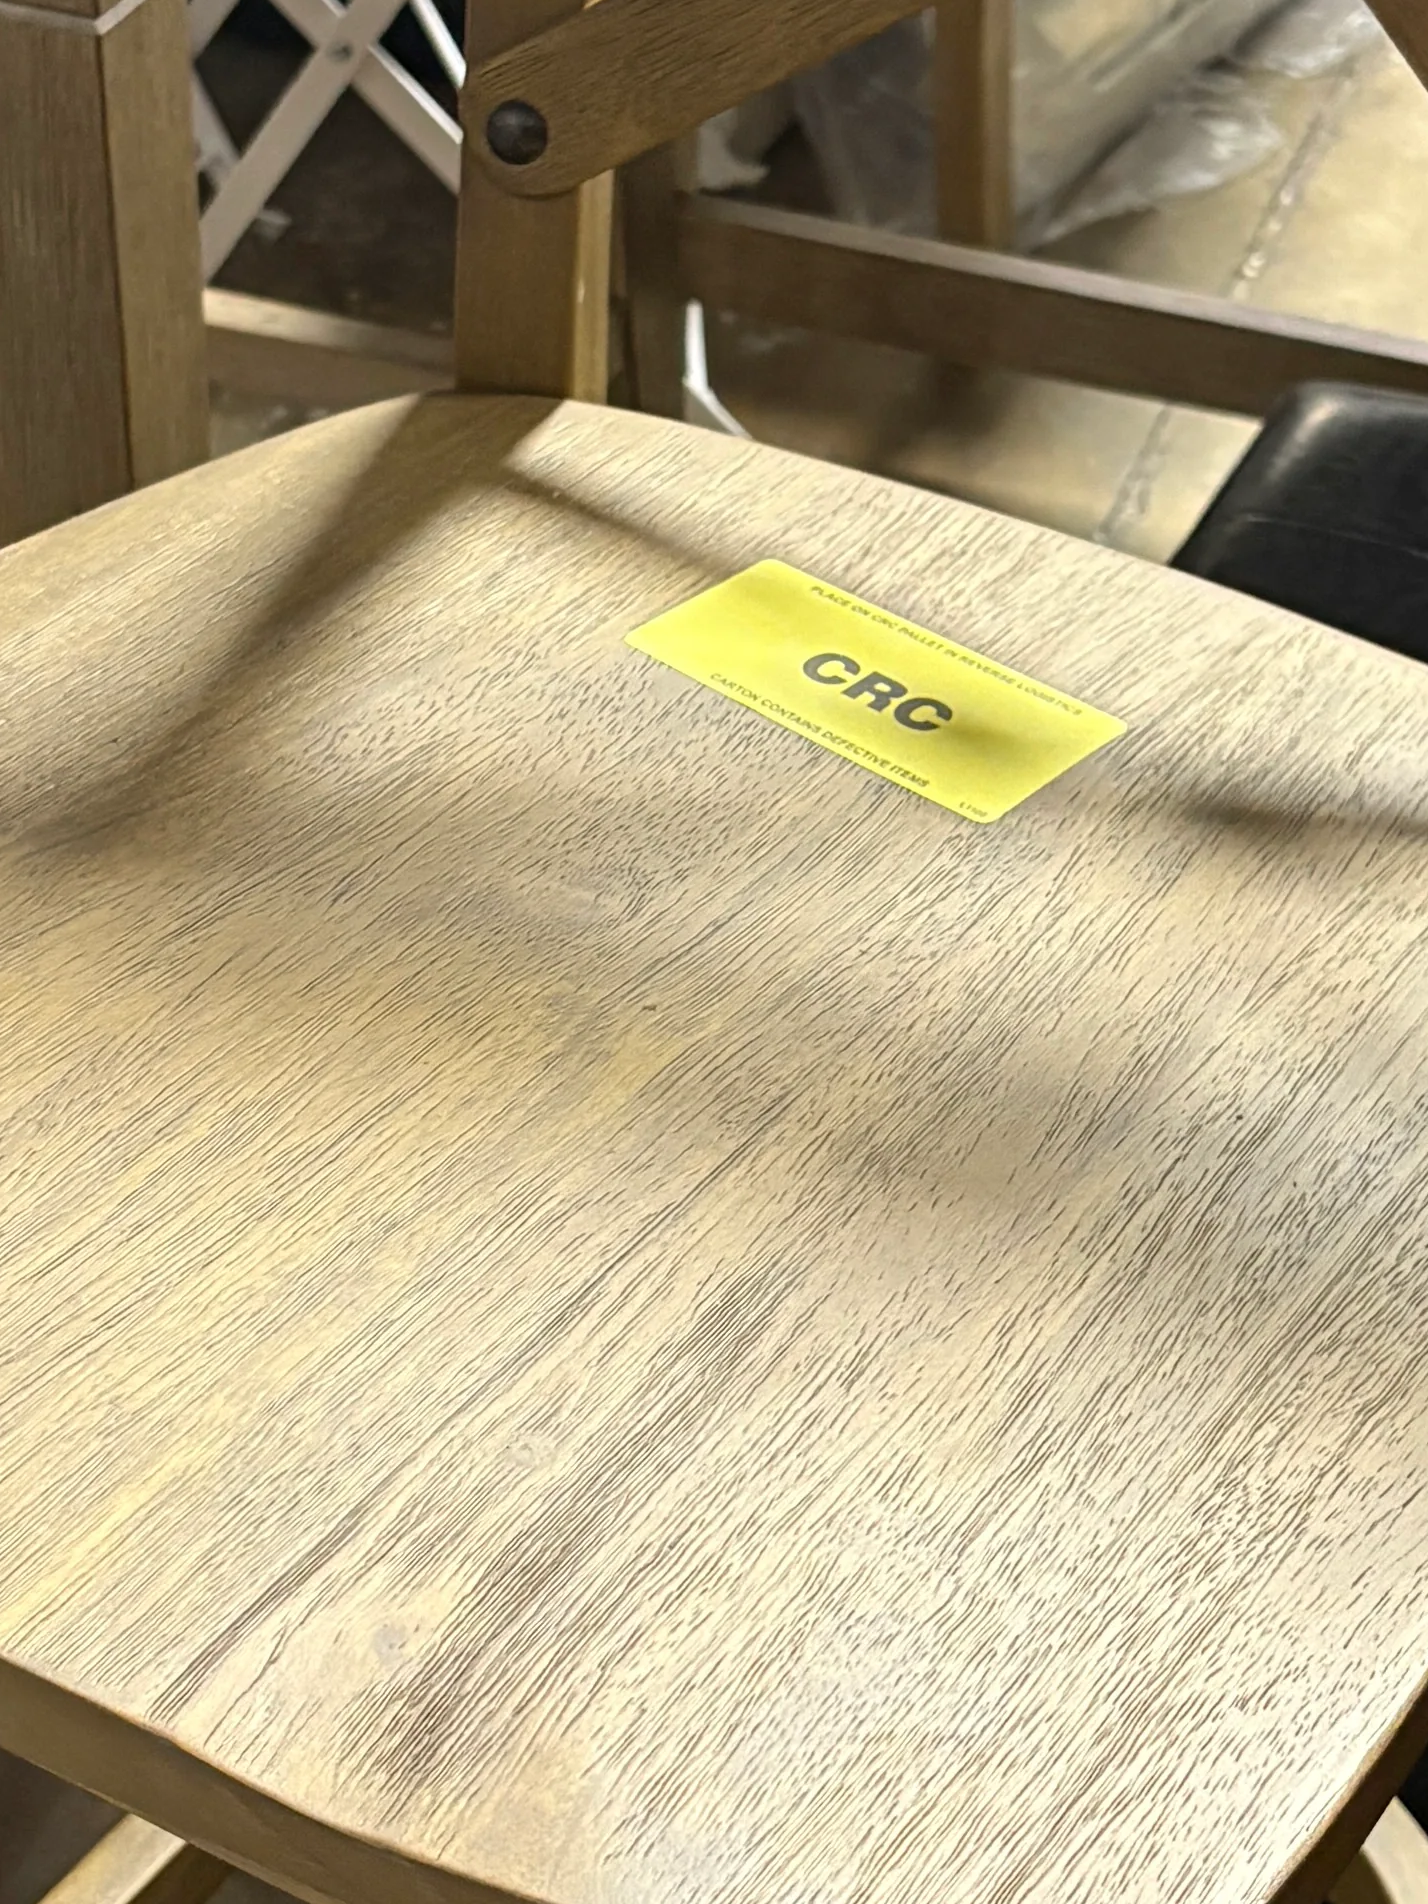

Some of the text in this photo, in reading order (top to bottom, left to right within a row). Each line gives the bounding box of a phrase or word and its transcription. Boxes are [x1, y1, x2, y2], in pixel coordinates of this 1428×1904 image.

[898, 626, 945, 651] PALLET
[710, 673, 931, 788] CARTON CONTAINS DEFECTIVE ITEMS
[802, 652, 954, 732] CRC
